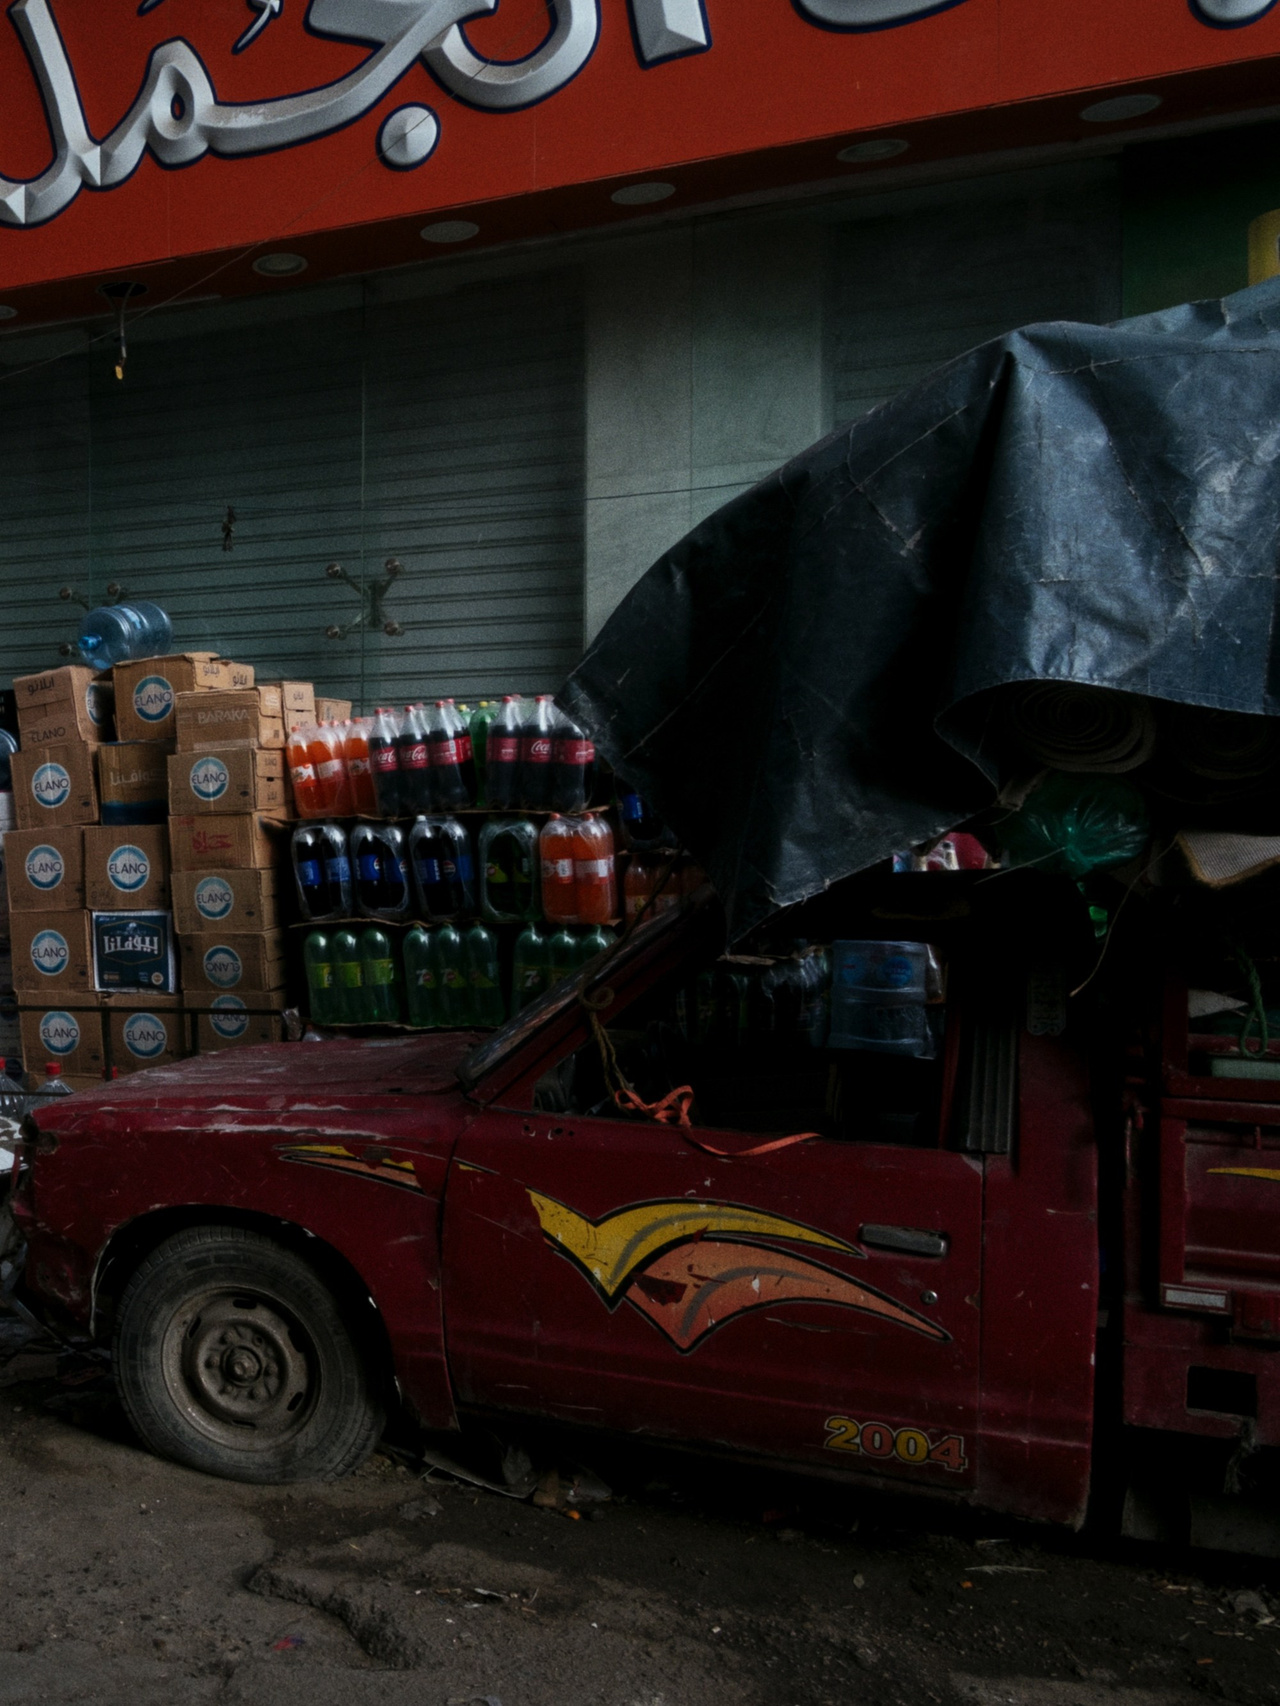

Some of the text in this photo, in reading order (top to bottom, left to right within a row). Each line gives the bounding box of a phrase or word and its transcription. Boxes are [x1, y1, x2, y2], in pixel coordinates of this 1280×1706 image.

[135, 691, 173, 706] ELANO
[197, 709, 251, 724] BARAKA
[32, 727, 66, 742] ELANO
[192, 772, 227, 785] ELANO
[34, 778, 69, 793] ELANO
[27, 862, 62, 874] ELANO
[109, 862, 148, 875] ELANO
[196, 892, 231, 904] ELANO
[32, 947, 67, 959] ELANO
[205, 963, 240, 974] ELANO
[212, 1010, 247, 1023] ELANO
[42, 1028, 78, 1039] ELANO
[126, 1031, 166, 1042] ELANO
[823, 1415, 969, 1474] 2004
